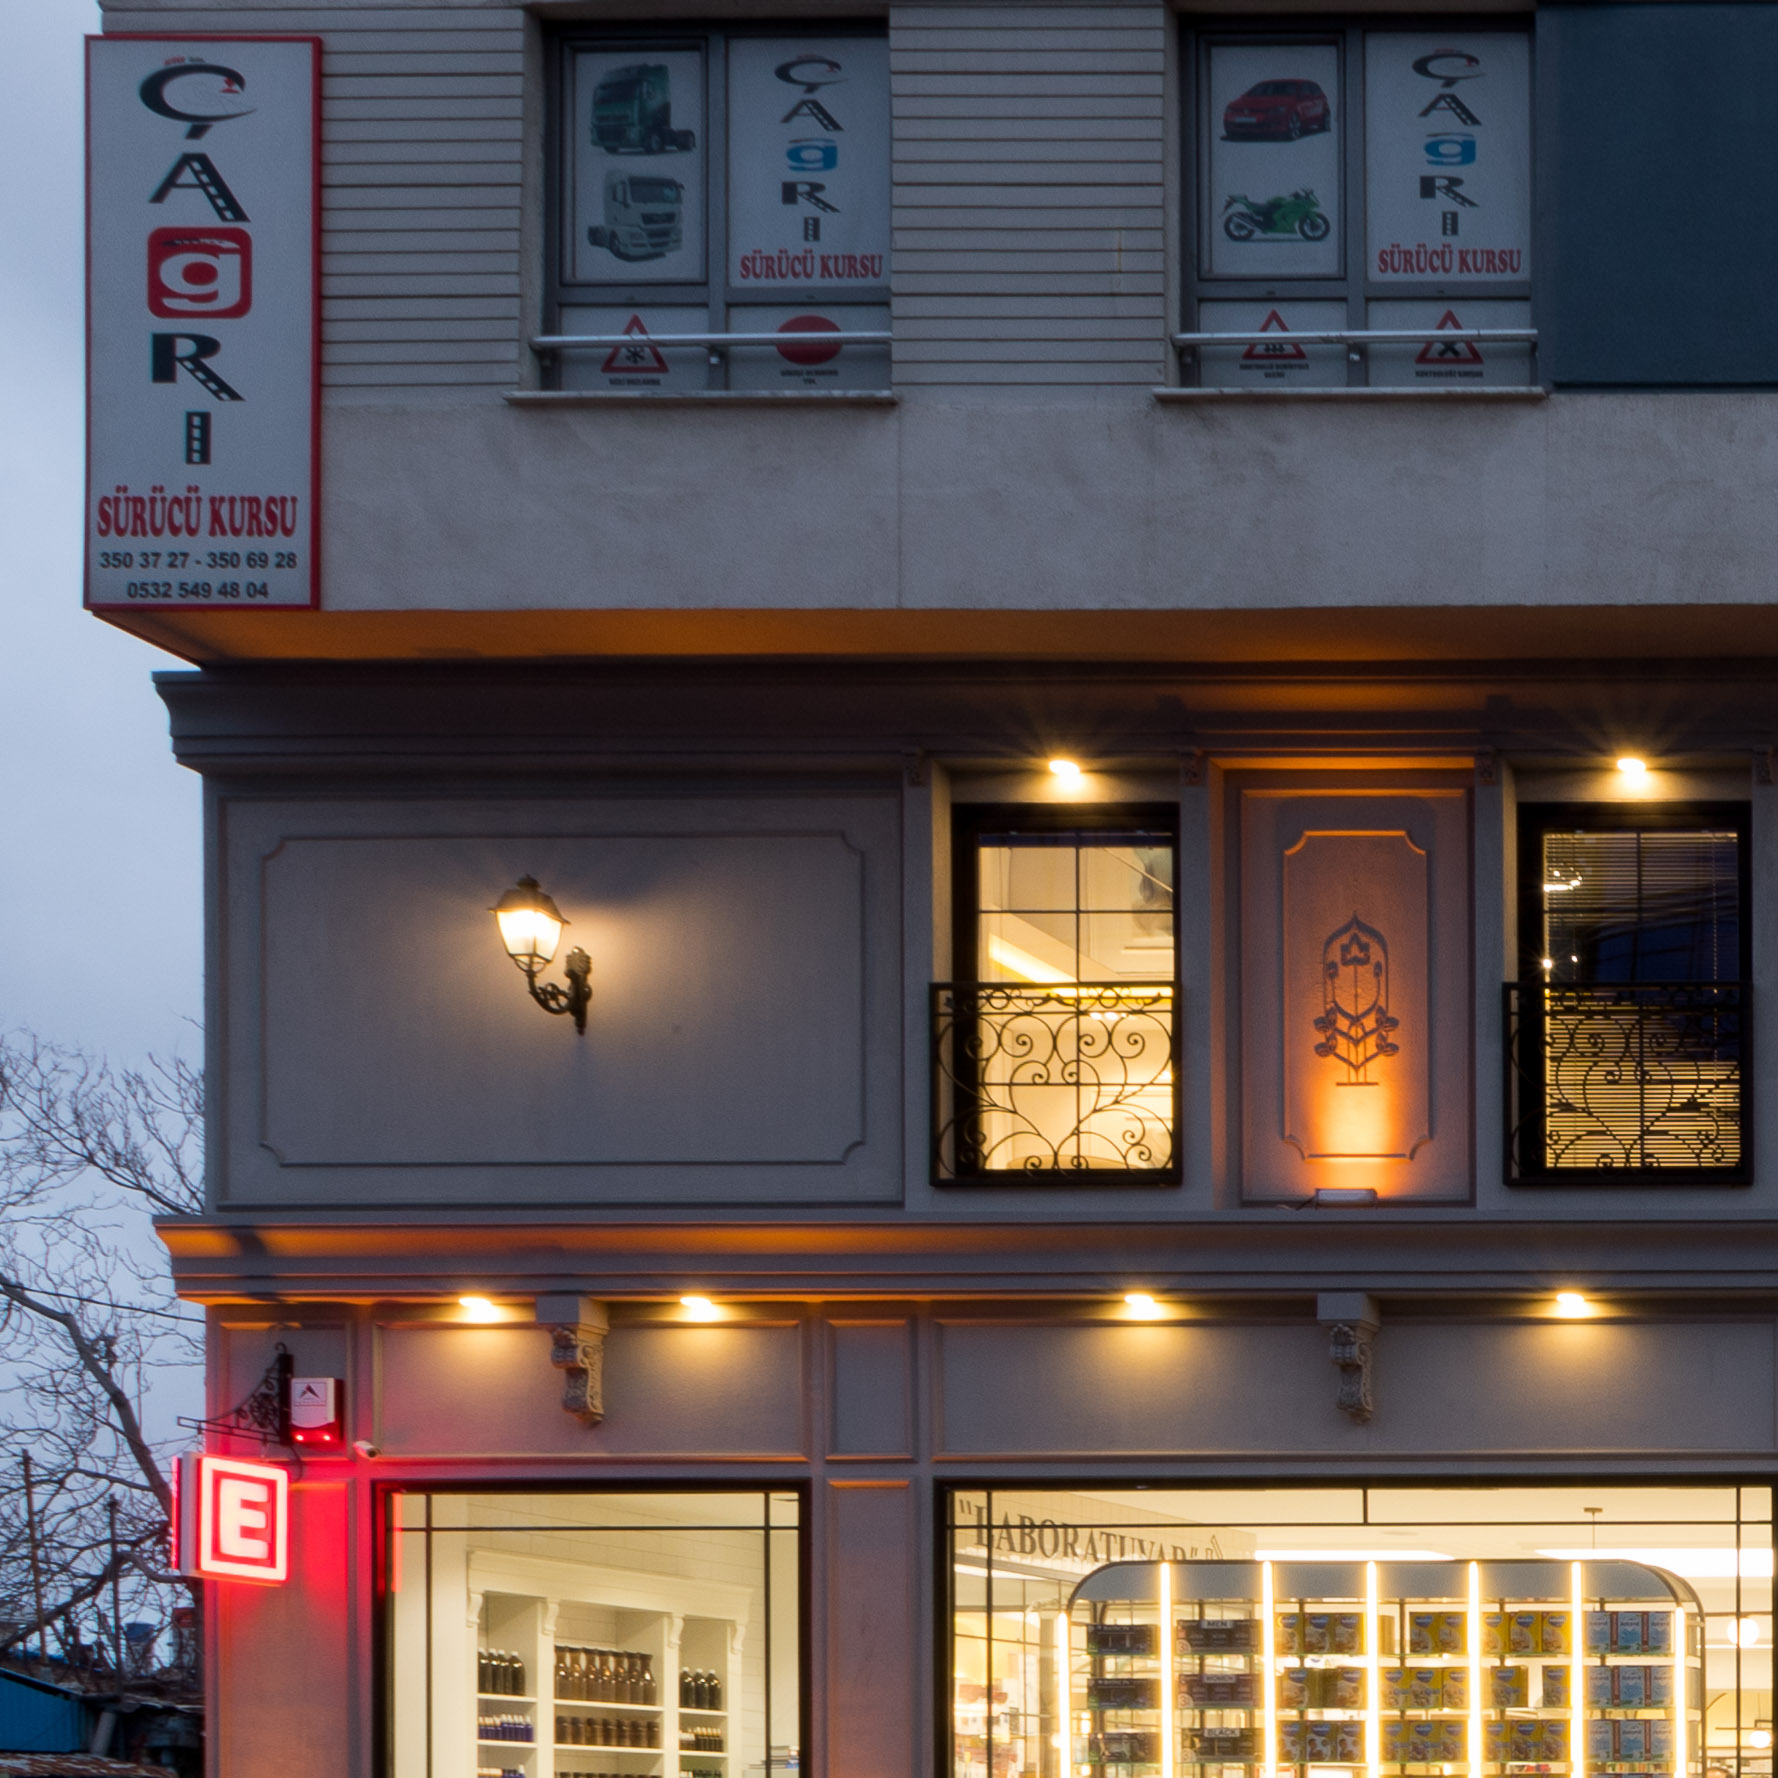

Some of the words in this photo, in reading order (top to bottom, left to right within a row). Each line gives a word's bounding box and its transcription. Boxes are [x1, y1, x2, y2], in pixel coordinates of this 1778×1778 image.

[740, 249, 815, 280] SÜRÜCÜ
[820, 254, 883, 280] KURSU
[1378, 243, 1453, 274] SÜRÜCÜ
[1458, 248, 1522, 274] KURSU
[97, 485, 203, 538] SÜRÜCÜ
[208, 495, 298, 538] KURSU
[100, 551, 133, 569] 350
[139, 551, 161, 569] 37
[168, 551, 190, 569] 27
[207, 551, 240, 569] 350
[246, 551, 269, 569] 69
[274, 551, 297, 569] 28
[127, 581, 172, 598] 0532
[178, 581, 212, 598] 549
[217, 581, 240, 598] 48
[246, 581, 269, 598] 04
[219, 1481, 269, 1560] E
